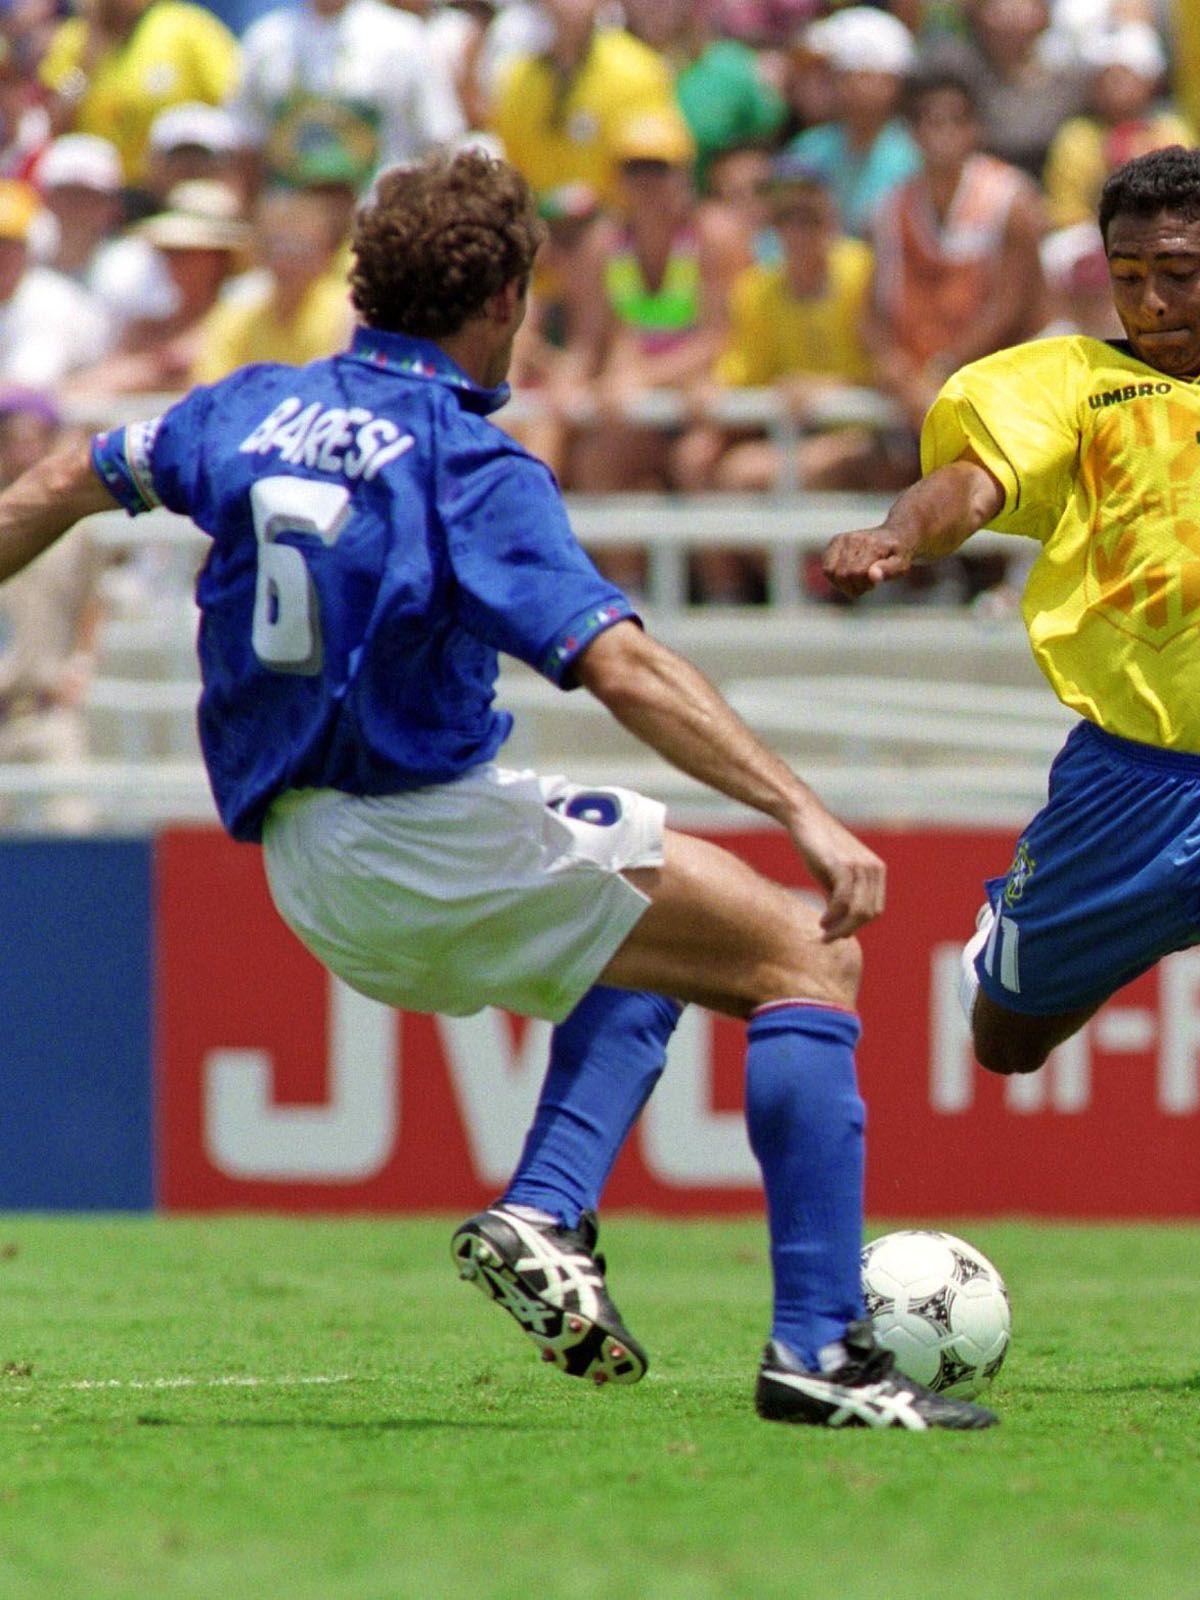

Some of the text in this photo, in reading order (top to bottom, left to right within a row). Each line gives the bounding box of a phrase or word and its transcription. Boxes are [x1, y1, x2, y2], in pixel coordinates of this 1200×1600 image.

[239, 396, 415, 482] BARESI
[1088, 382, 1172, 410] UMBRO
[250, 475, 350, 676] 6
